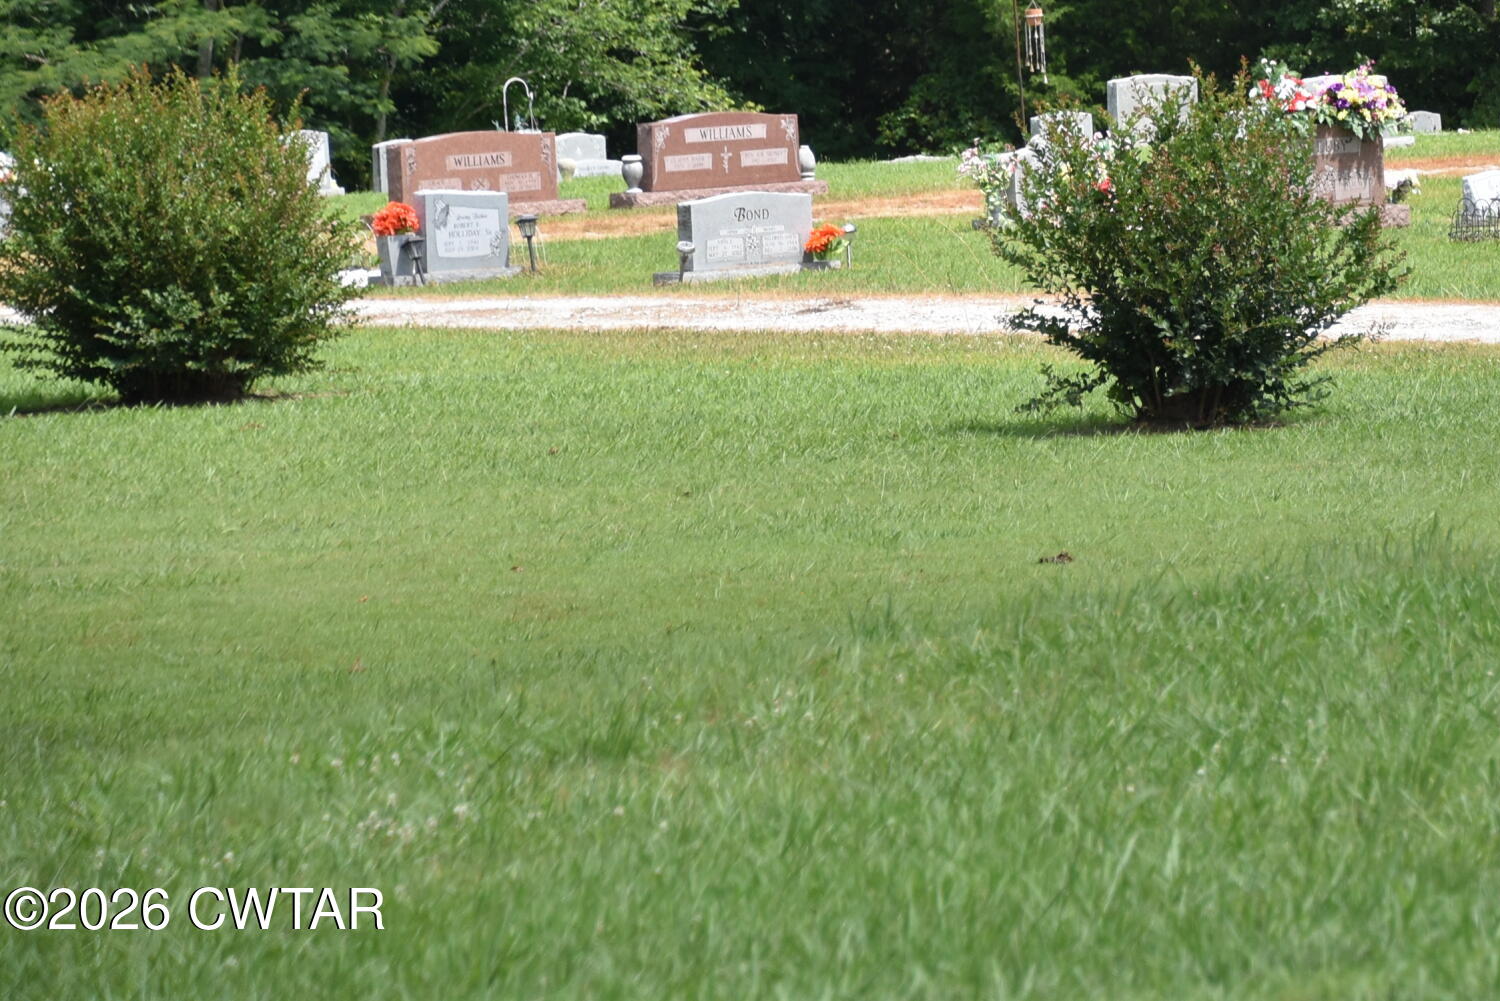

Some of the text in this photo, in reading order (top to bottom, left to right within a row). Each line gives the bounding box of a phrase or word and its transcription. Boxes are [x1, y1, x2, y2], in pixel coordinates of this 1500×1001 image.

[700, 126, 753, 140] WILLIAMS
[453, 153, 506, 167] WILLIAMS
[734, 207, 770, 222] BOND
